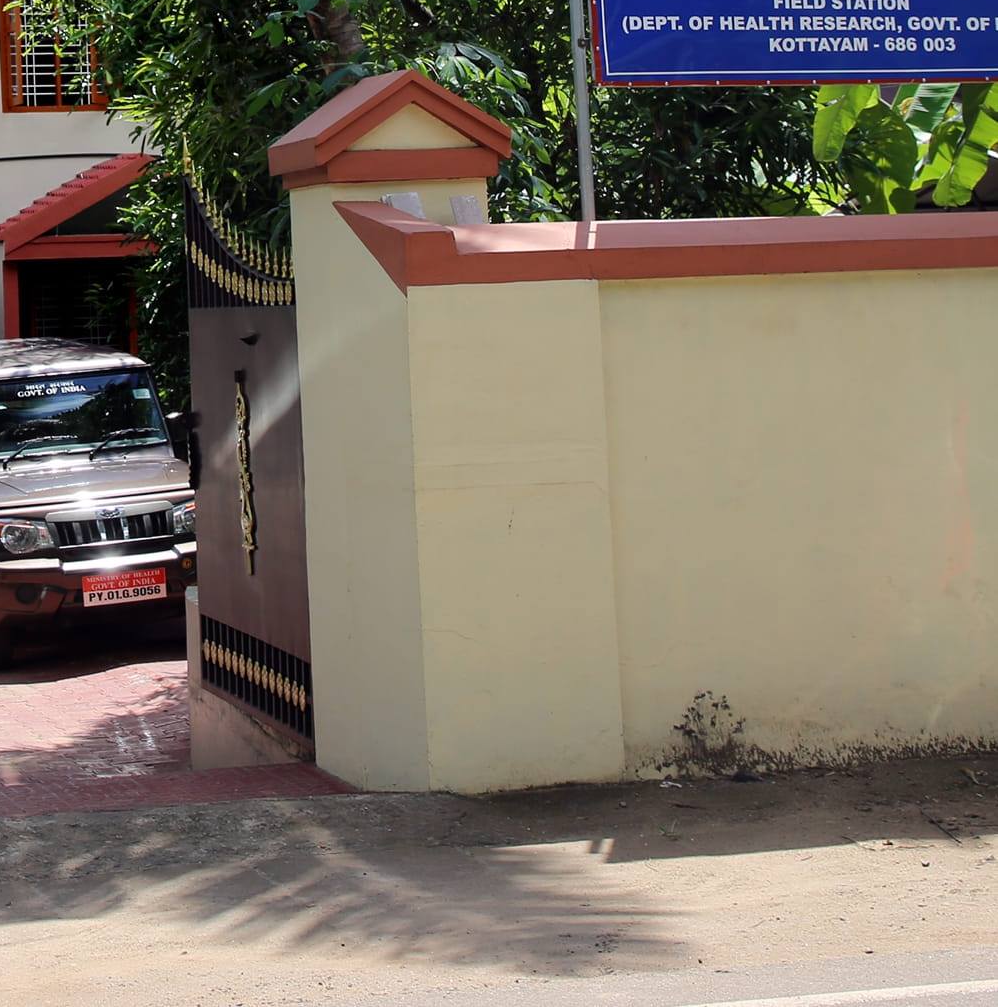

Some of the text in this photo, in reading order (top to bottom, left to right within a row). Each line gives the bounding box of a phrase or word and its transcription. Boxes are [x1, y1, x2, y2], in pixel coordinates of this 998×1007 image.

[622, 16, 683, 33] (DEPT.
[689, 17, 714, 30] OF
[720, 17, 794, 30] HEALTH
[800, 17, 902, 33] RESEARCH,
[907, 17, 960, 31] GOVT.
[966, 17, 990, 31] OF
[769, 38, 868, 52] KOTTAYAM
[885, 38, 917, 52] 686
[924, 38, 956, 52] 003
[61, 385, 86, 393] INDIA
[133, 570, 160, 578] HEALTH
[91, 577, 156, 590] GOVT. OF INDIA
[89, 585, 160, 602] PY.01.G.9056
